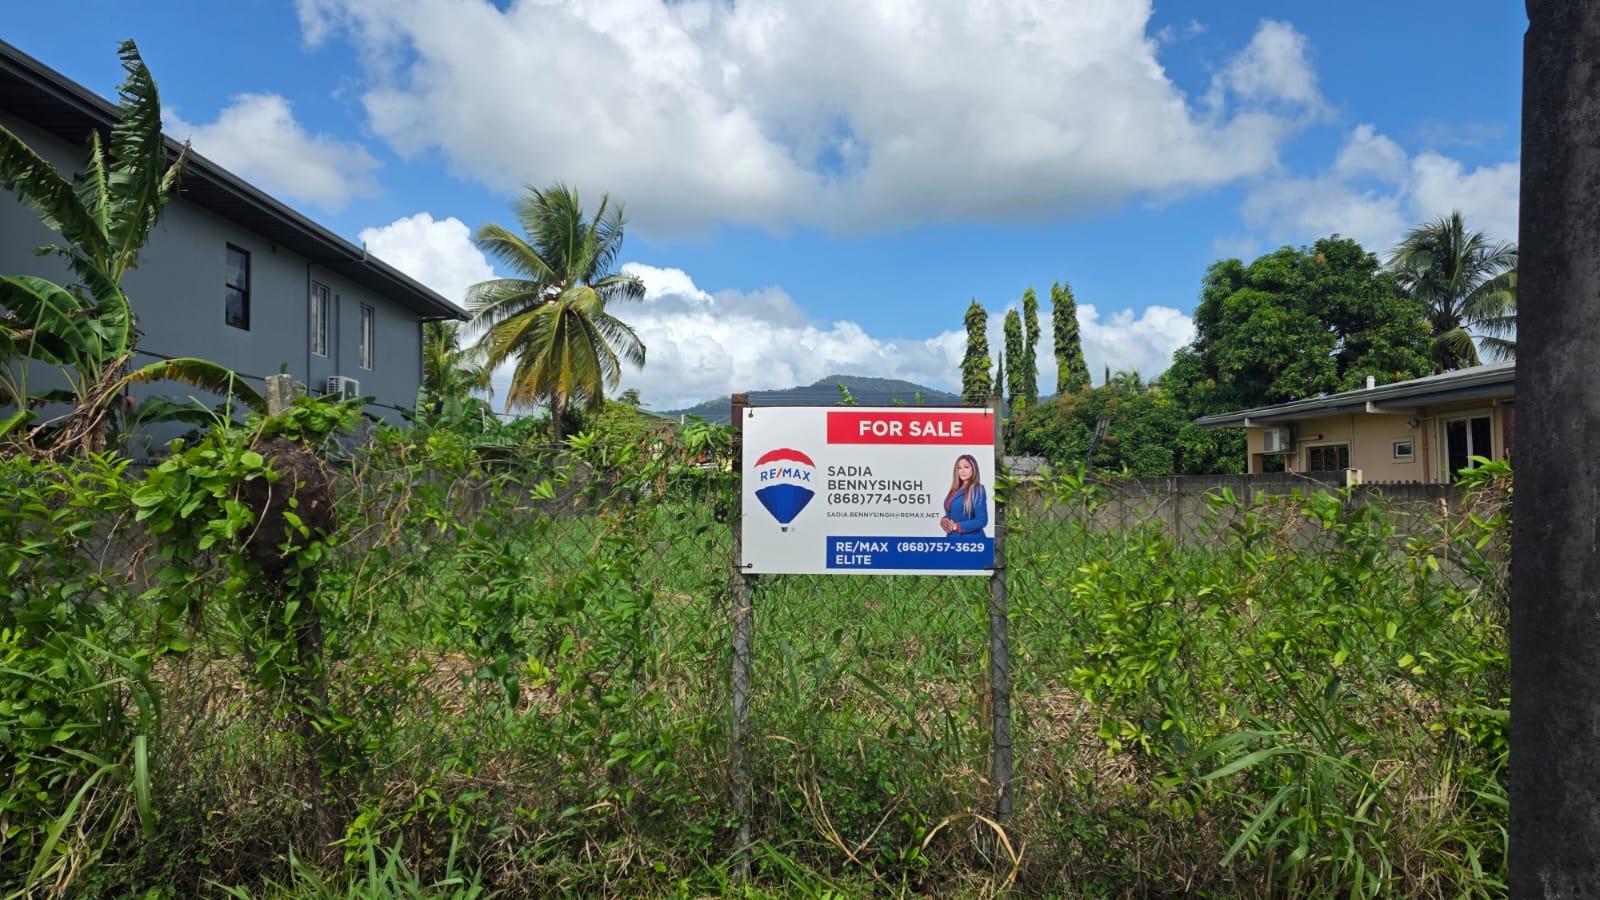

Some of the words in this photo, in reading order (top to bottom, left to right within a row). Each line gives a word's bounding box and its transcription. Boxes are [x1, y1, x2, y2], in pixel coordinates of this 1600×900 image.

[859, 420, 903, 437] FOR
[909, 420, 963, 437] SALE
[760, 467, 811, 482] RE/MAX
[827, 465, 873, 477] SADIA
[827, 480, 923, 491] BENNYSINGH
[827, 493, 931, 505] (868)774-0561
[836, 541, 888, 553] RE/MAX
[897, 542, 985, 553] (868)757-3629
[836, 555, 872, 565] ELITE
